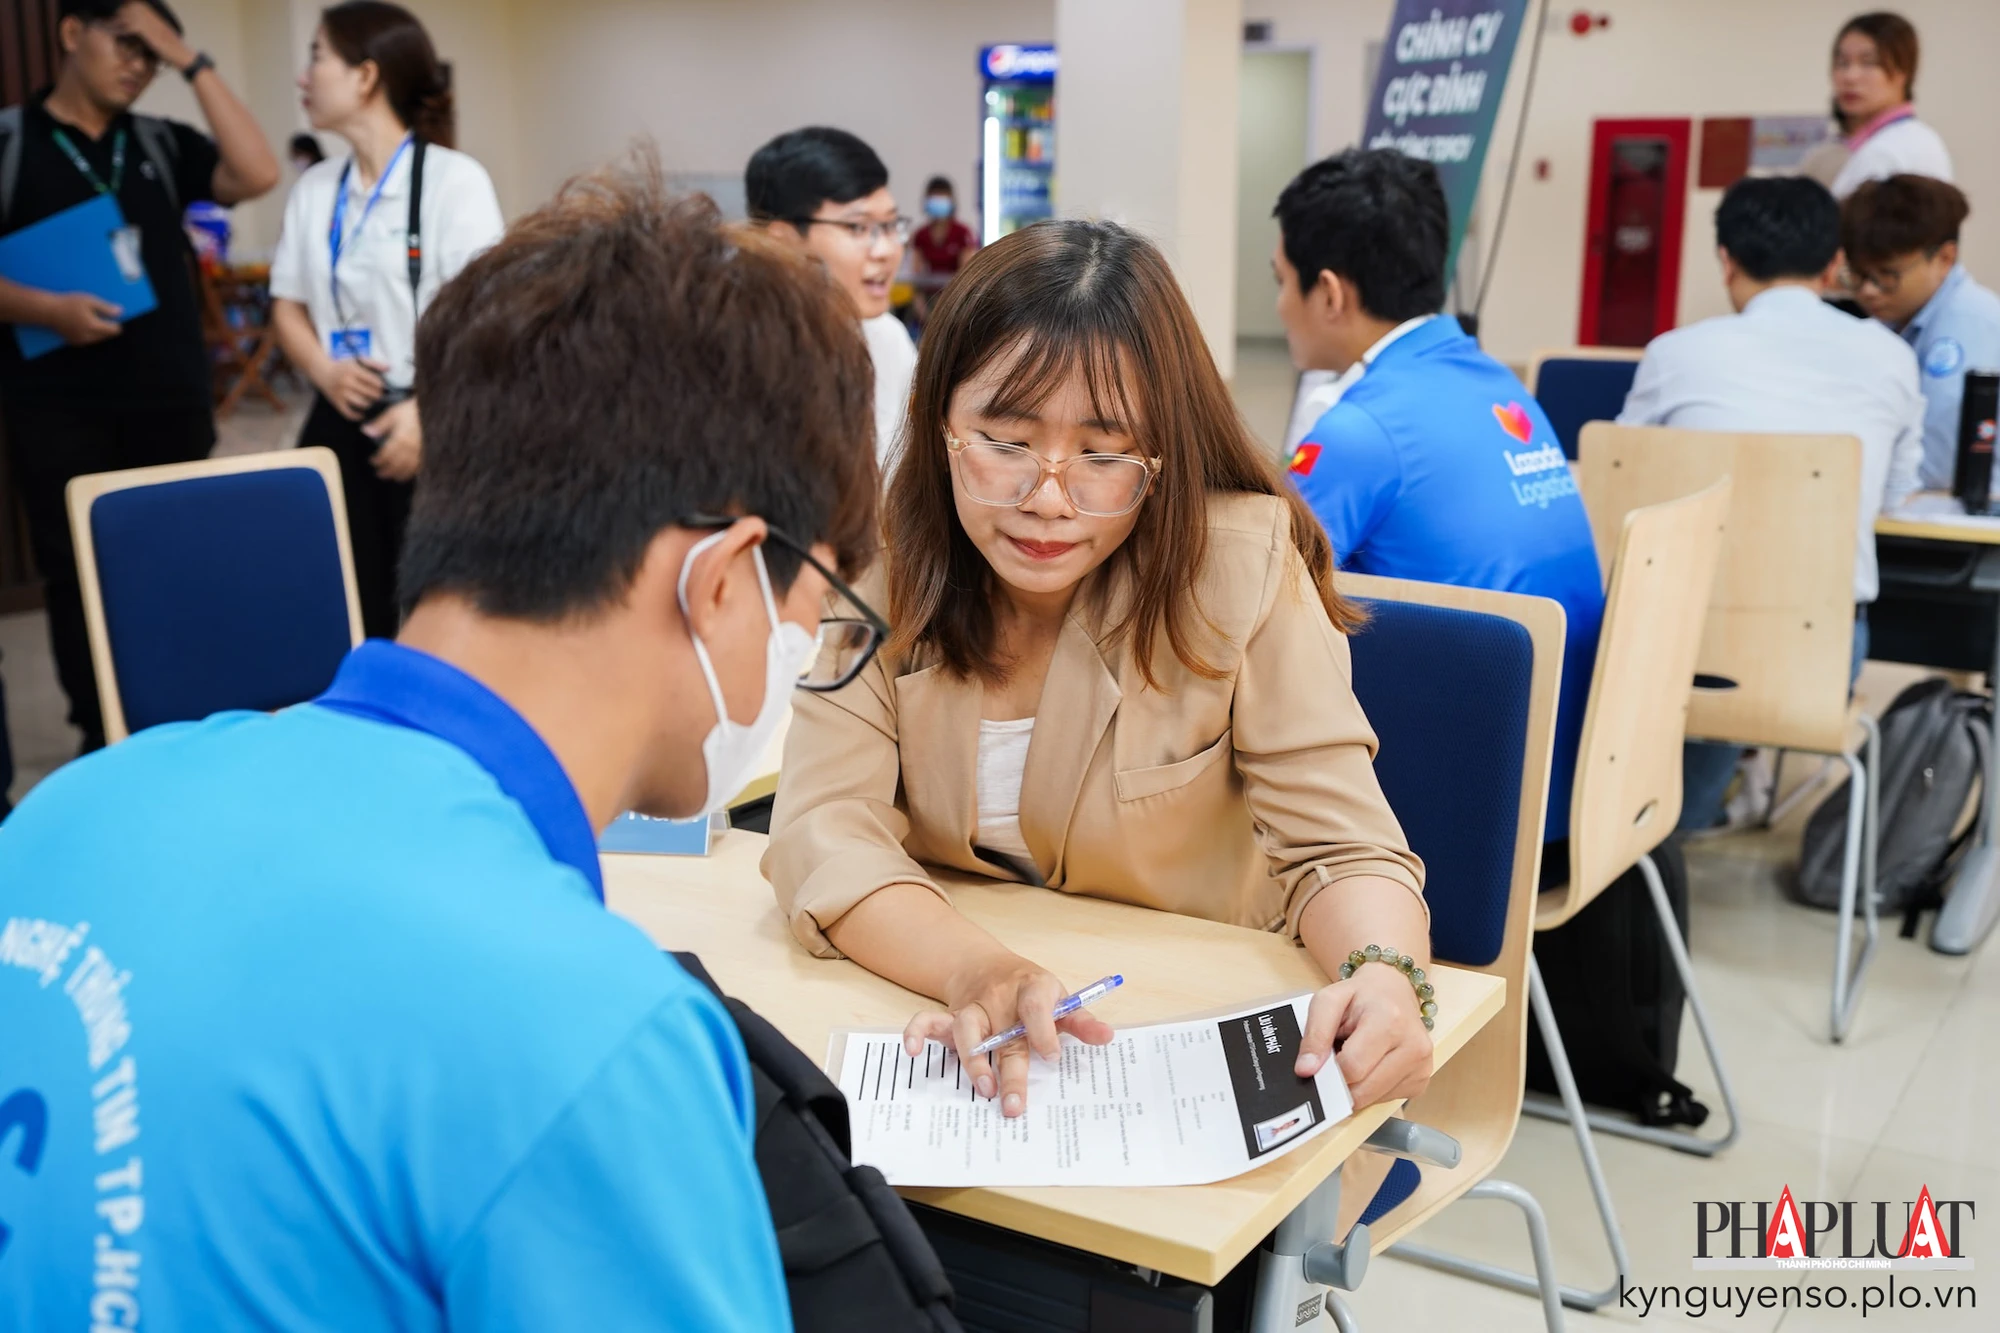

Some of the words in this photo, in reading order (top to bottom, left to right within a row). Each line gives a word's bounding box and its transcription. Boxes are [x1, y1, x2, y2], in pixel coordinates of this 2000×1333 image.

[1465, 10, 1504, 56] CV
[1264, 1036, 1282, 1054] PHÁT
[91, 1055, 140, 1155] TIN
